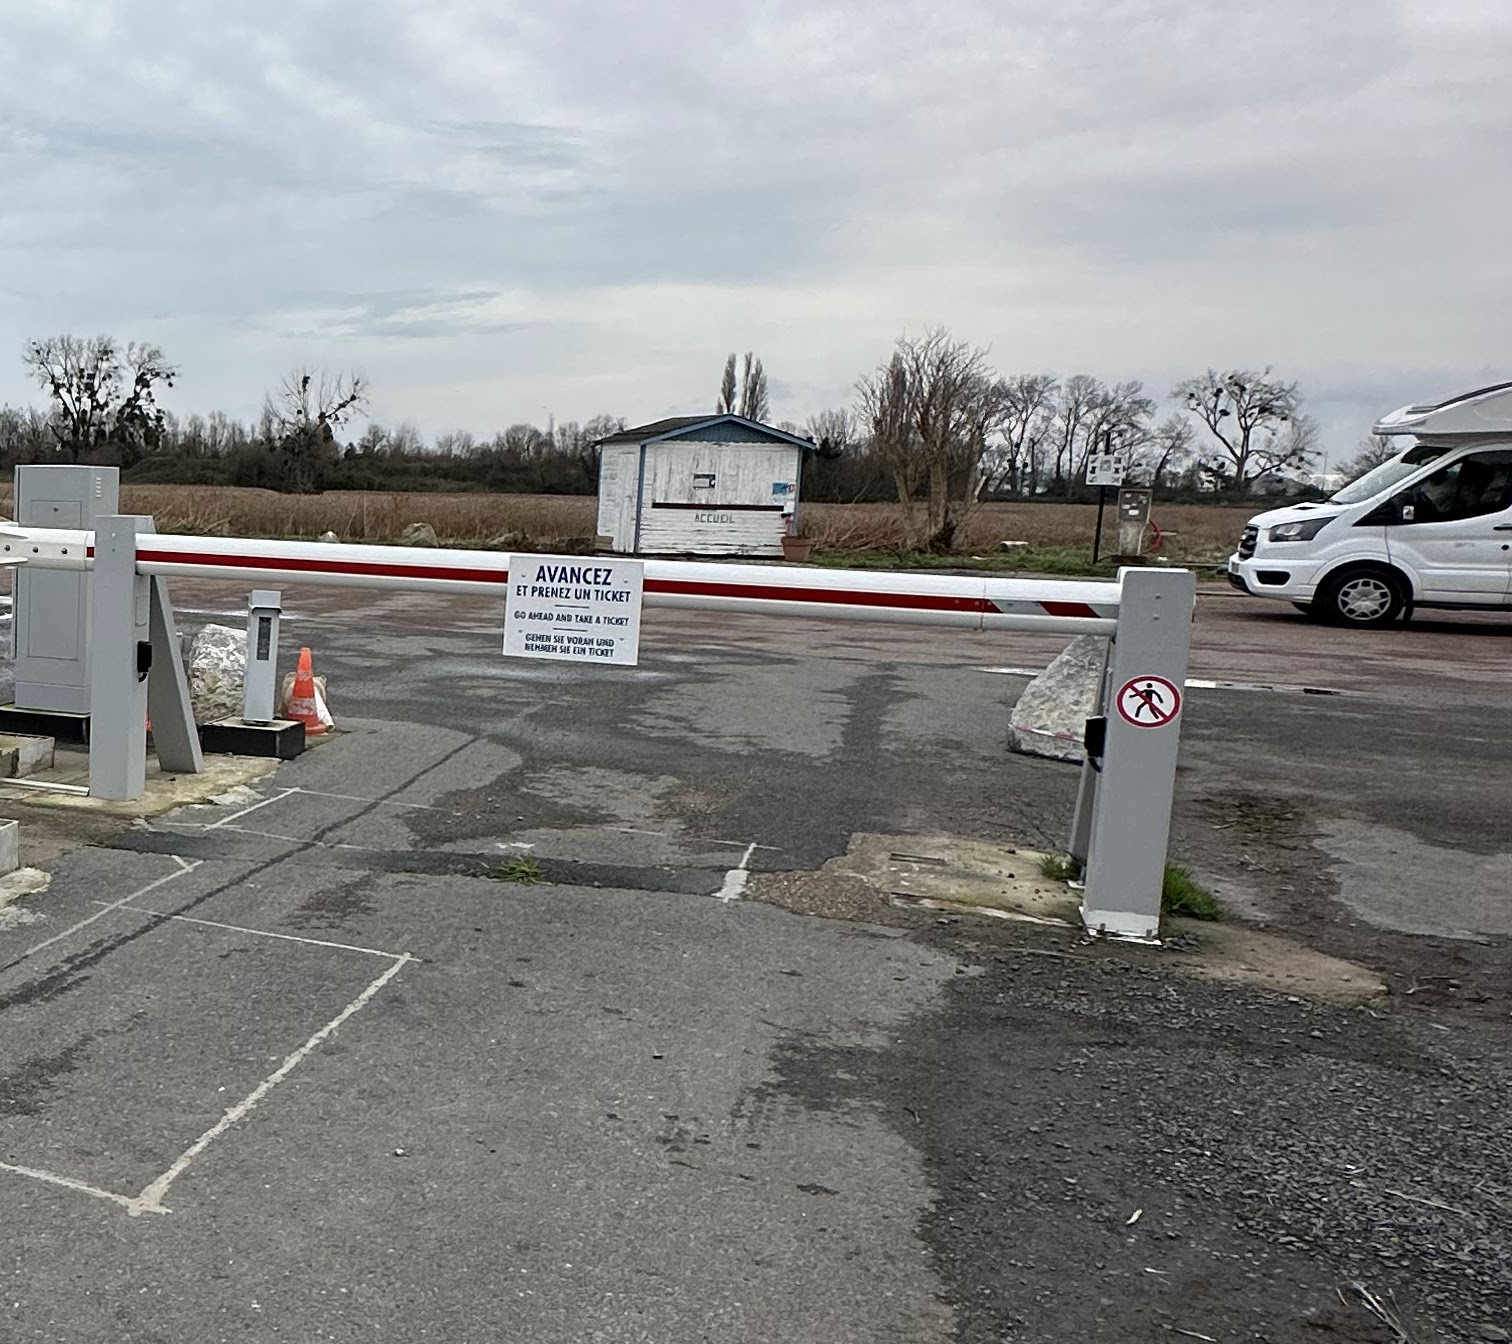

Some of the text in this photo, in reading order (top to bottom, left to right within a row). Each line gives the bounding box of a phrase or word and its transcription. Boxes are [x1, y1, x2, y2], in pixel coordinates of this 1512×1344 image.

[695, 513, 735, 523] ACCUEIL
[536, 565, 613, 586] AVANCEZ
[516, 585, 631, 602] ET PRENEZ UN TICKET
[514, 610, 629, 626] GO AHEAD AND TAKE A TICKET
[553, 635, 564, 644] SIE
[596, 638, 615, 647] UND
[559, 645, 570, 655] SIE
[572, 646, 586, 656] EIN
[588, 647, 615, 657] TICKET
